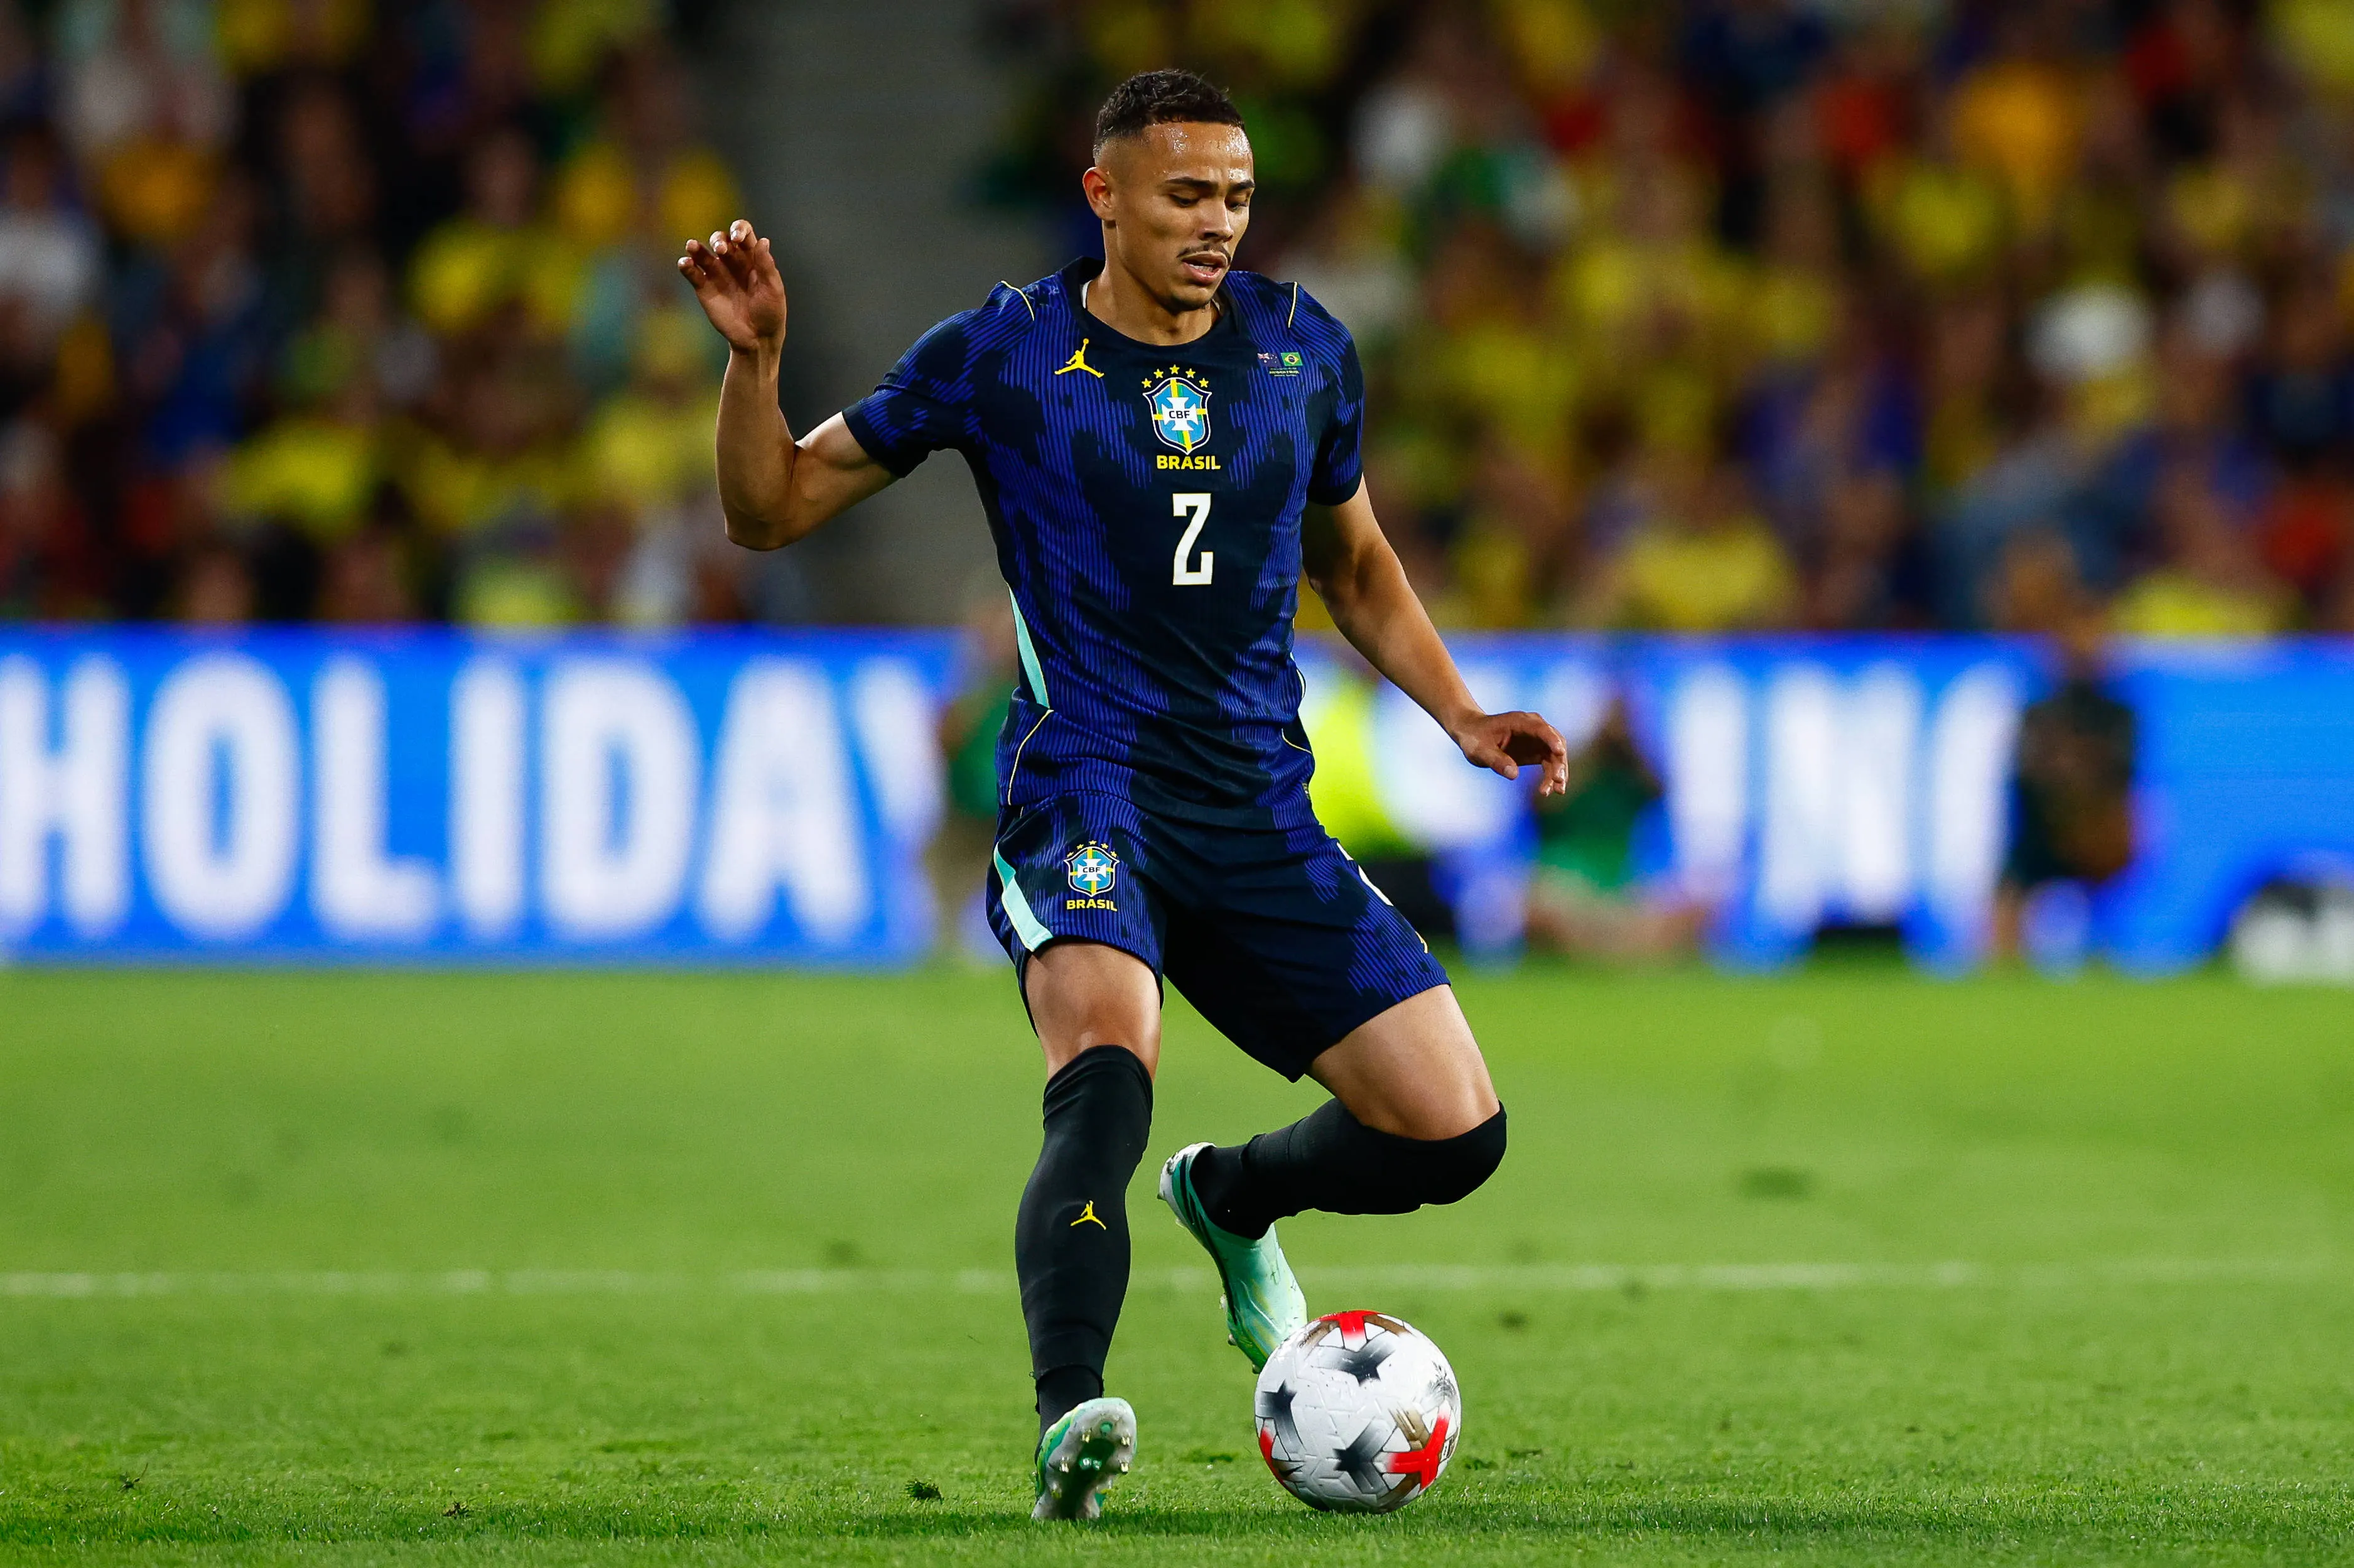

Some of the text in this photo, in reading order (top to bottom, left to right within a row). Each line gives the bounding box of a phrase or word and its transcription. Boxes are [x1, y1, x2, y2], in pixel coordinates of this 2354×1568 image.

[1169, 410, 1190, 419] CBF
[1157, 455, 1221, 470] BRASIL
[1172, 492, 1214, 585] 2
[1066, 899, 1118, 912] BRASIL
